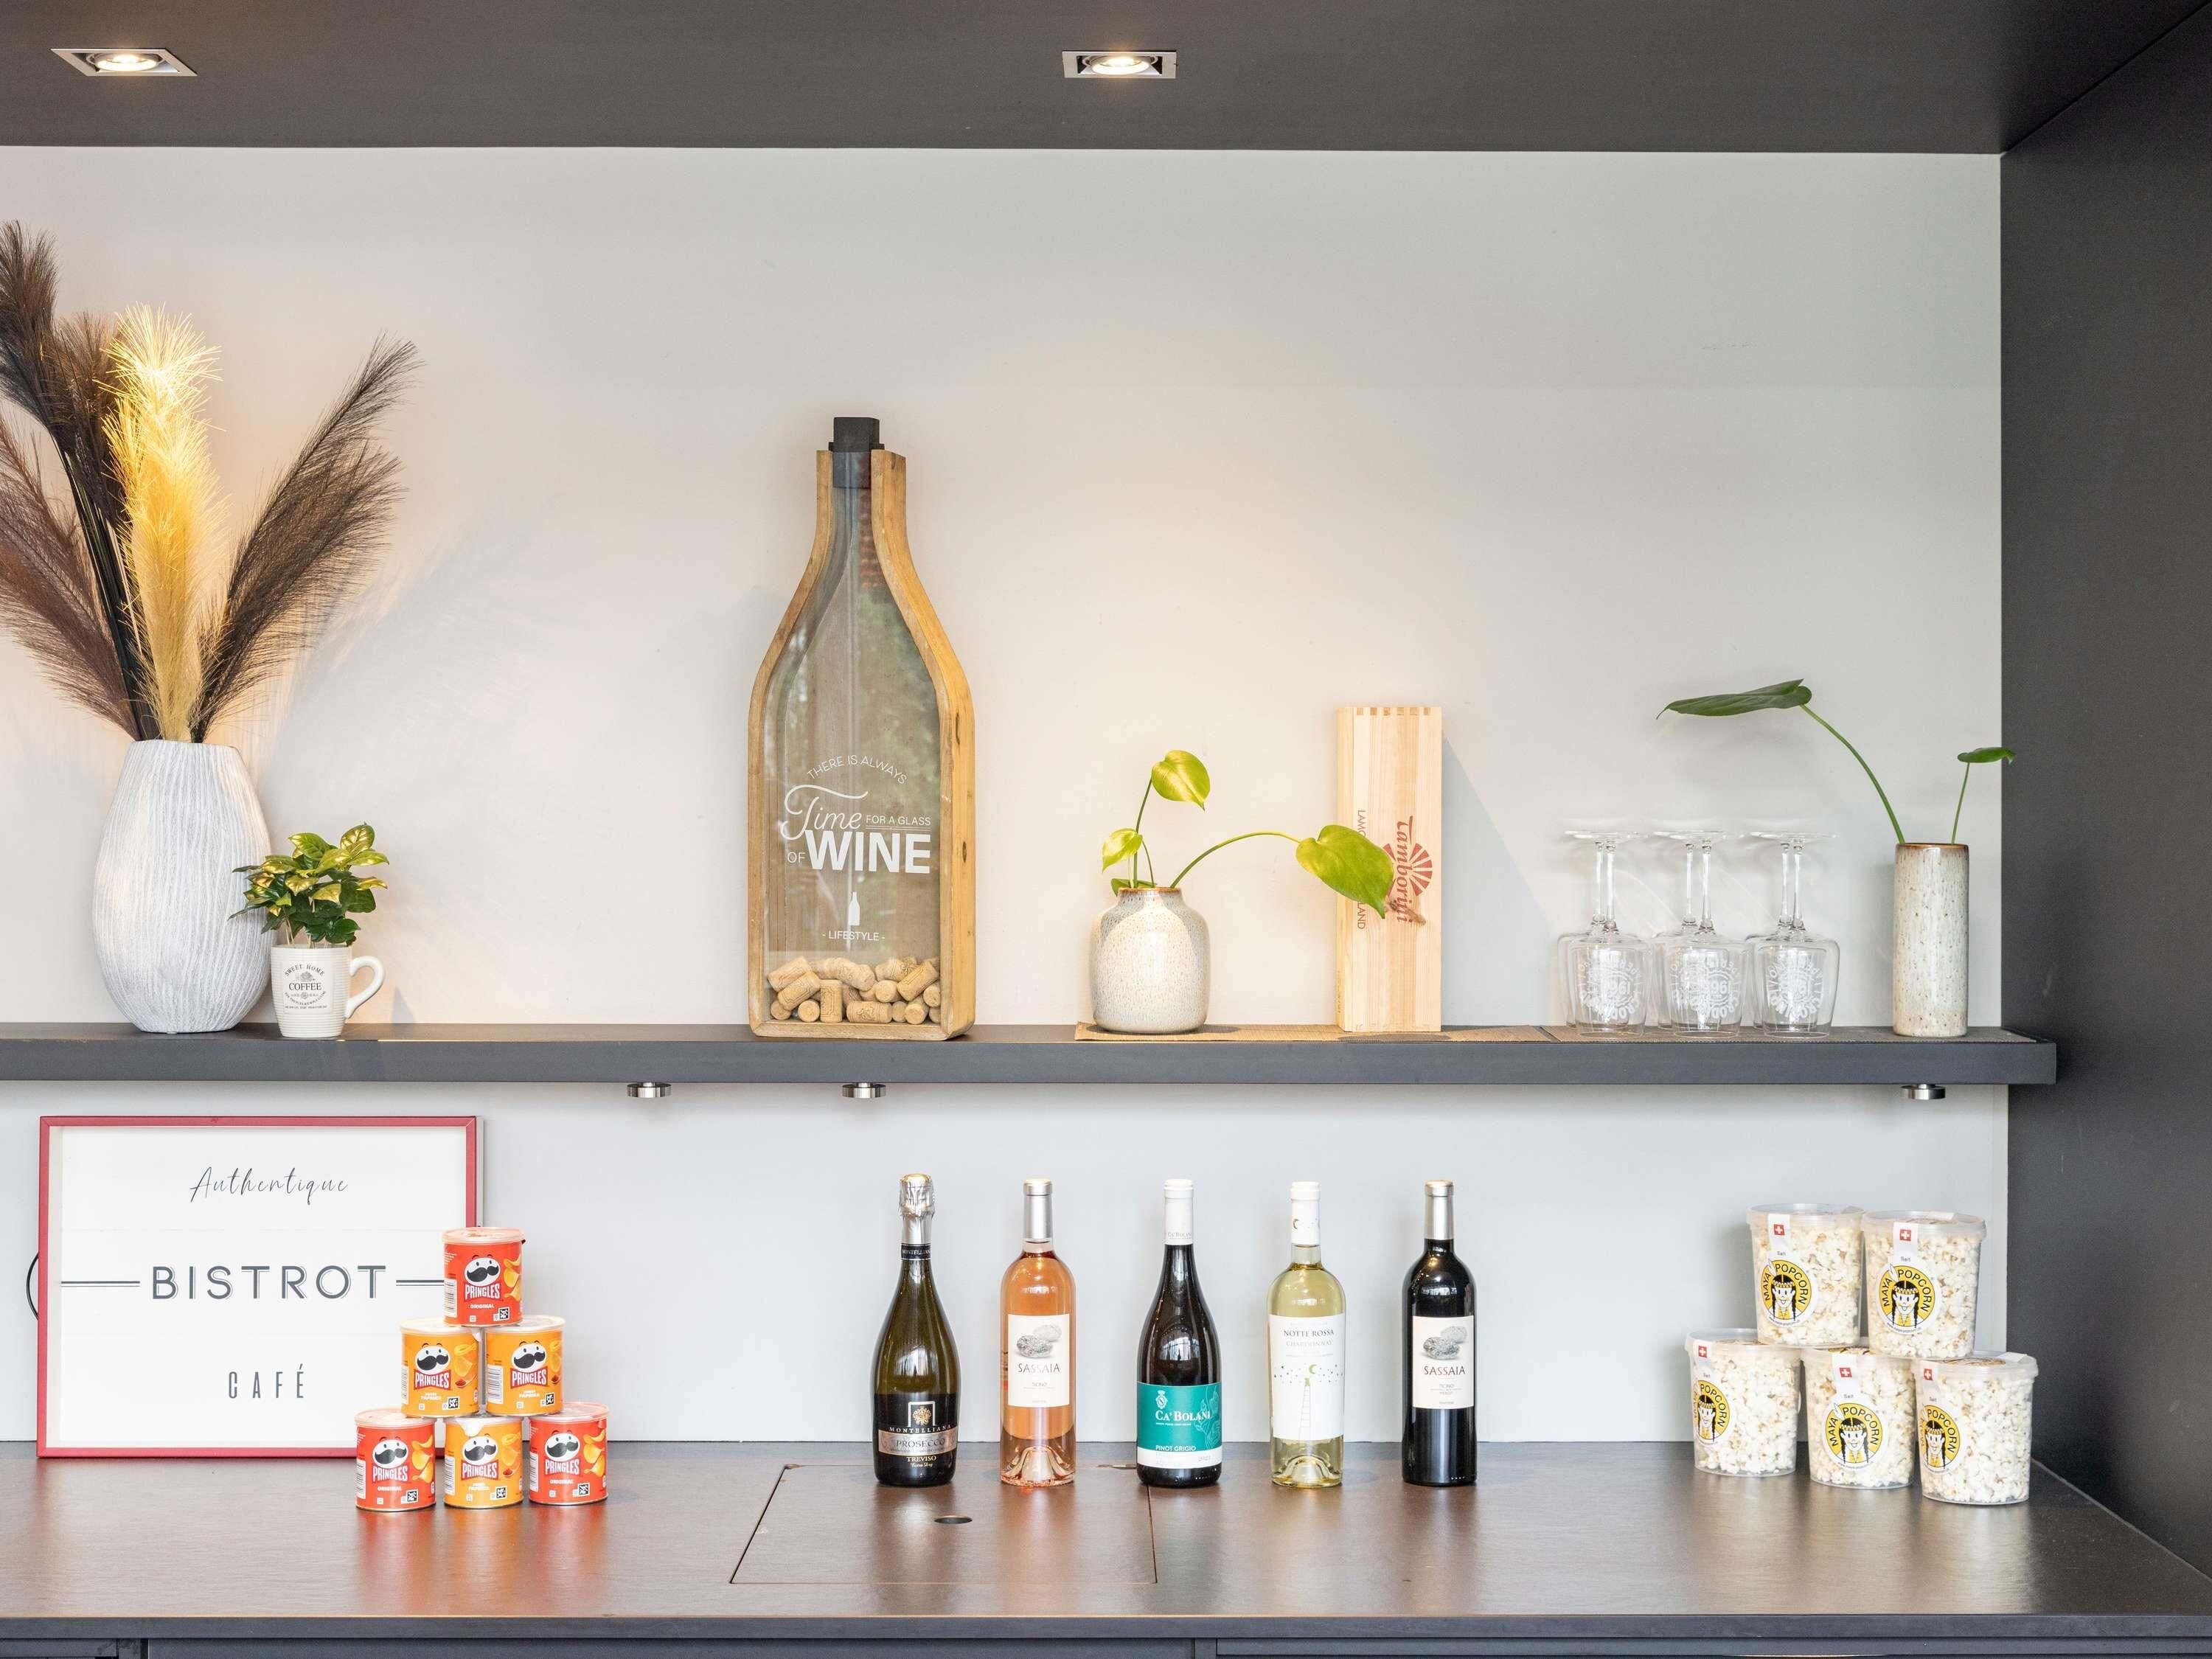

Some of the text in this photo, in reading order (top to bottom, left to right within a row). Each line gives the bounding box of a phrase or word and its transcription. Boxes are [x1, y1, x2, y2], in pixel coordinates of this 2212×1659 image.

[807, 754, 908, 785] THERE IS ALWAYS
[780, 784, 932, 841] Time FOR A GLASS
[787, 830, 932, 874] OF WINE
[828, 930, 880, 942] LIFESTYLE
[285, 964, 325, 977] SWEET HOME
[288, 982, 322, 991] COFFEE
[190, 1166, 349, 1206] Authentique
[151, 1265, 387, 1300] BISTROT
[465, 1283, 501, 1300] PRINGLES
[1763, 1273, 1771, 1301] MAYA
[1775, 1263, 1808, 1305] POPCORN
[1882, 1278, 1893, 1307] MAYA
[1897, 1269, 1932, 1312] POPCORN
[229, 1364, 305, 1399] CAFÉ
[414, 1372, 450, 1389] PRINGLES
[512, 1368, 547, 1387] PRINGLES
[1424, 1366, 1466, 1376] SASSAIA
[1700, 1384, 1728, 1427] POPCORN
[1828, 1417, 1838, 1447] MAYA
[1843, 1406, 1879, 1445] POPCORN
[1927, 1408, 1957, 1453] POPCORN
[897, 1439, 945, 1448] PROSECCO
[372, 1465, 408, 1482] PRINGLES
[462, 1461, 498, 1478] PRINGLES
[546, 1458, 580, 1475] PRINGLES
